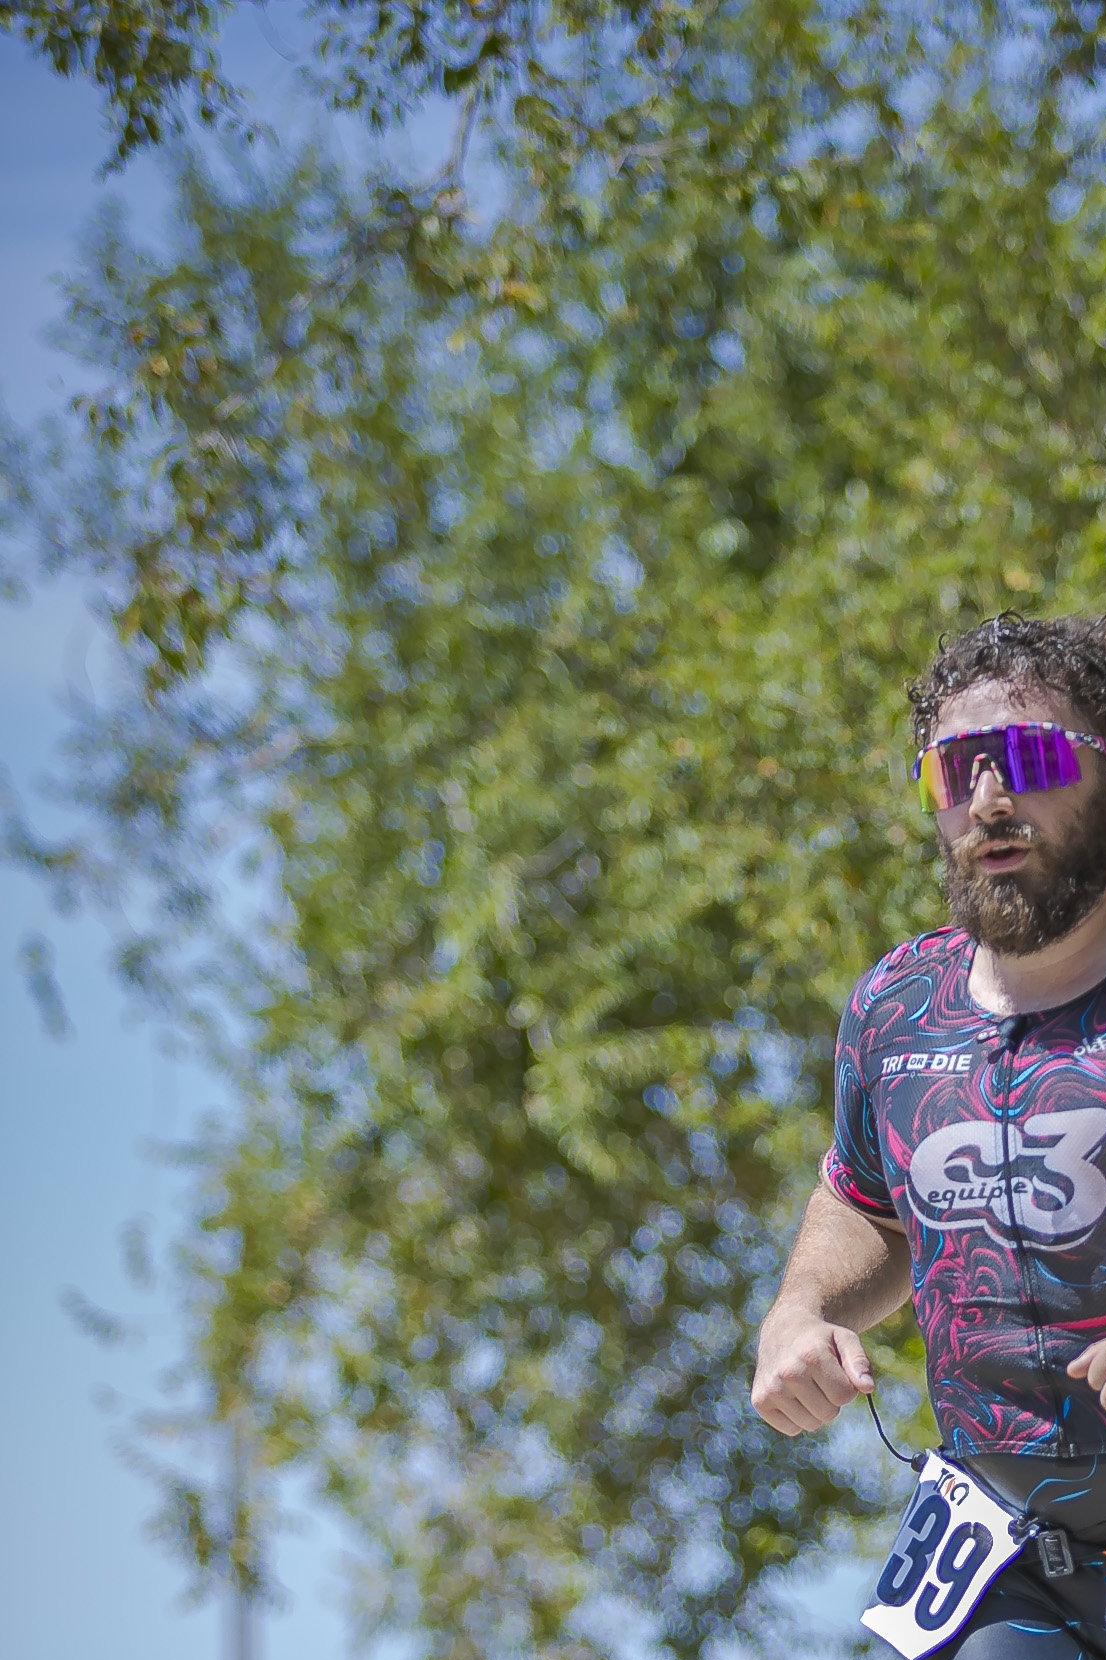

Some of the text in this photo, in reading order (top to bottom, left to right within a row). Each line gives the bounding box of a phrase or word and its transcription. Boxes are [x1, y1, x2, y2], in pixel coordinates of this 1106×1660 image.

[881, 1054, 904, 1074] TRI
[930, 1054, 973, 1071] DIE
[927, 1182, 1028, 1210] equipe
[876, 1493, 994, 1631] 39
